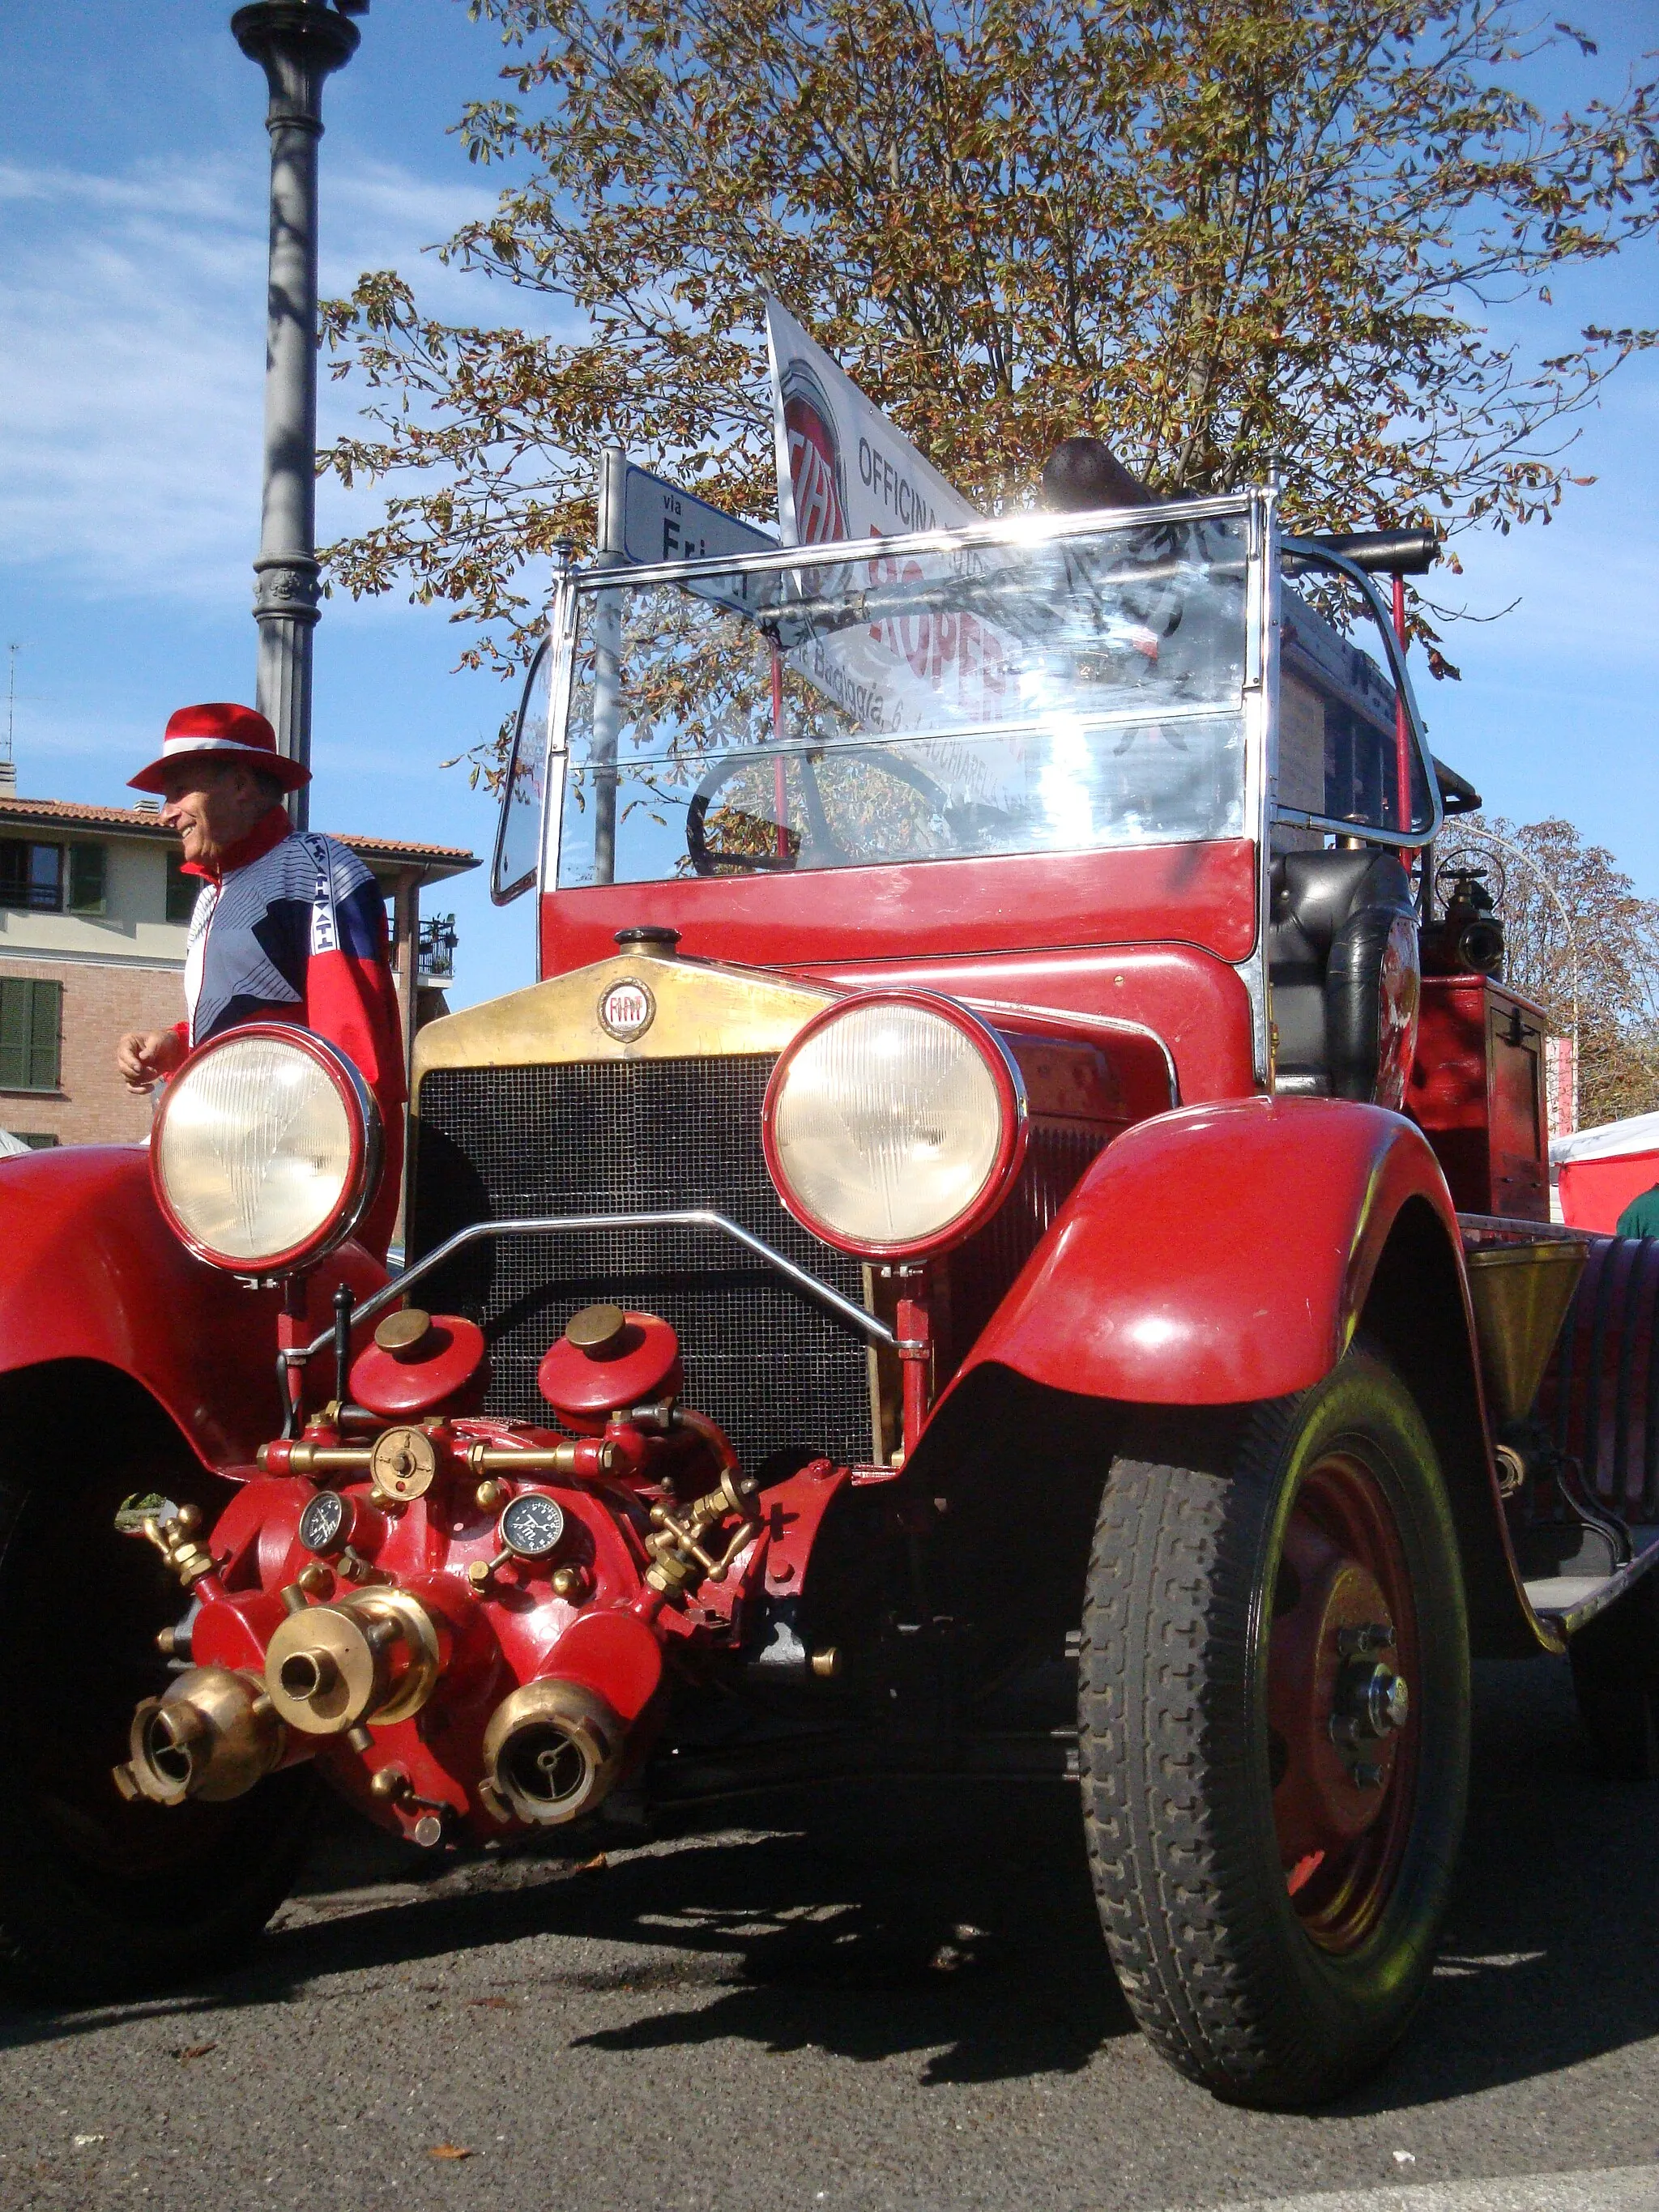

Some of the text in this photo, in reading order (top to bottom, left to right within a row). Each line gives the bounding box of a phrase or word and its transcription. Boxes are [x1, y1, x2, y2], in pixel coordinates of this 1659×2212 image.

[787, 428, 835, 544] FIAT
[663, 494, 681, 516] via
[610, 996, 642, 1022] FIAT
